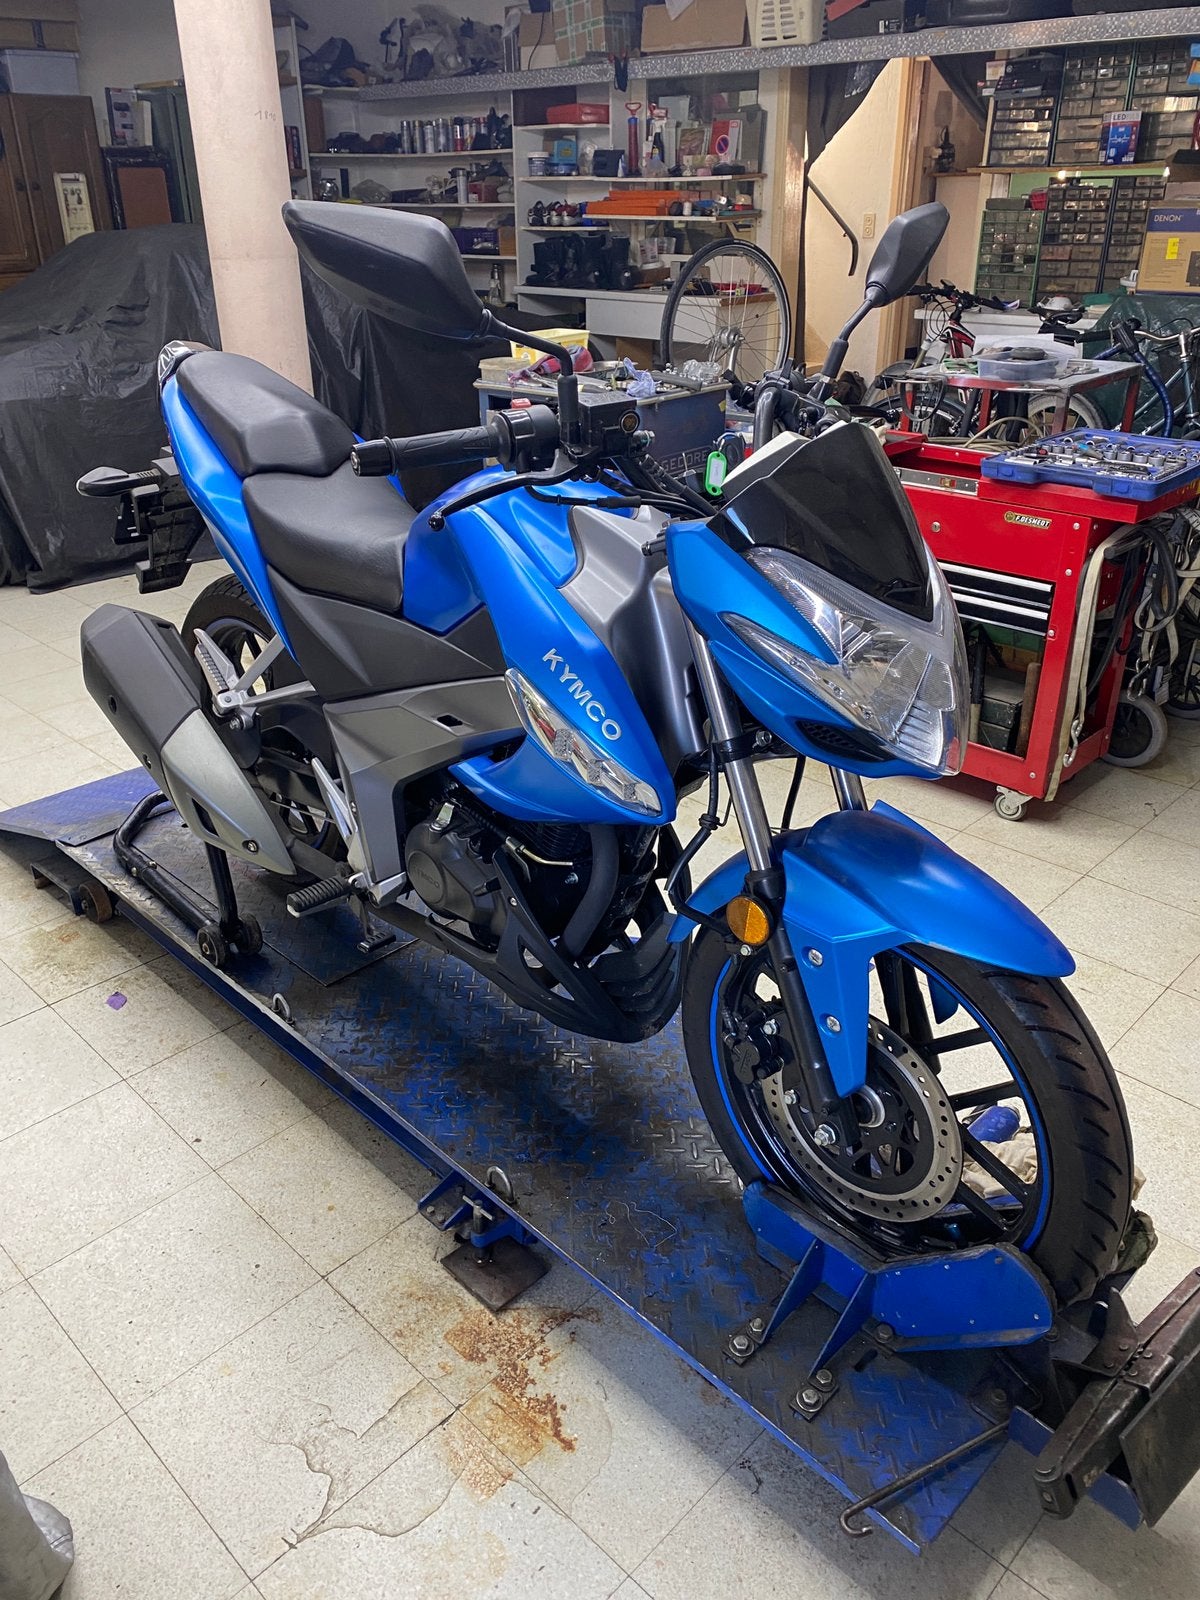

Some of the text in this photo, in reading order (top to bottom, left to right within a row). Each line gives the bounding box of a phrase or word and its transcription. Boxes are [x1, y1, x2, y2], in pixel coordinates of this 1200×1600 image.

[1113, 113, 1127, 121] LED
[1153, 214, 1182, 222] DENON
[542, 647, 622, 741] KYMCO
